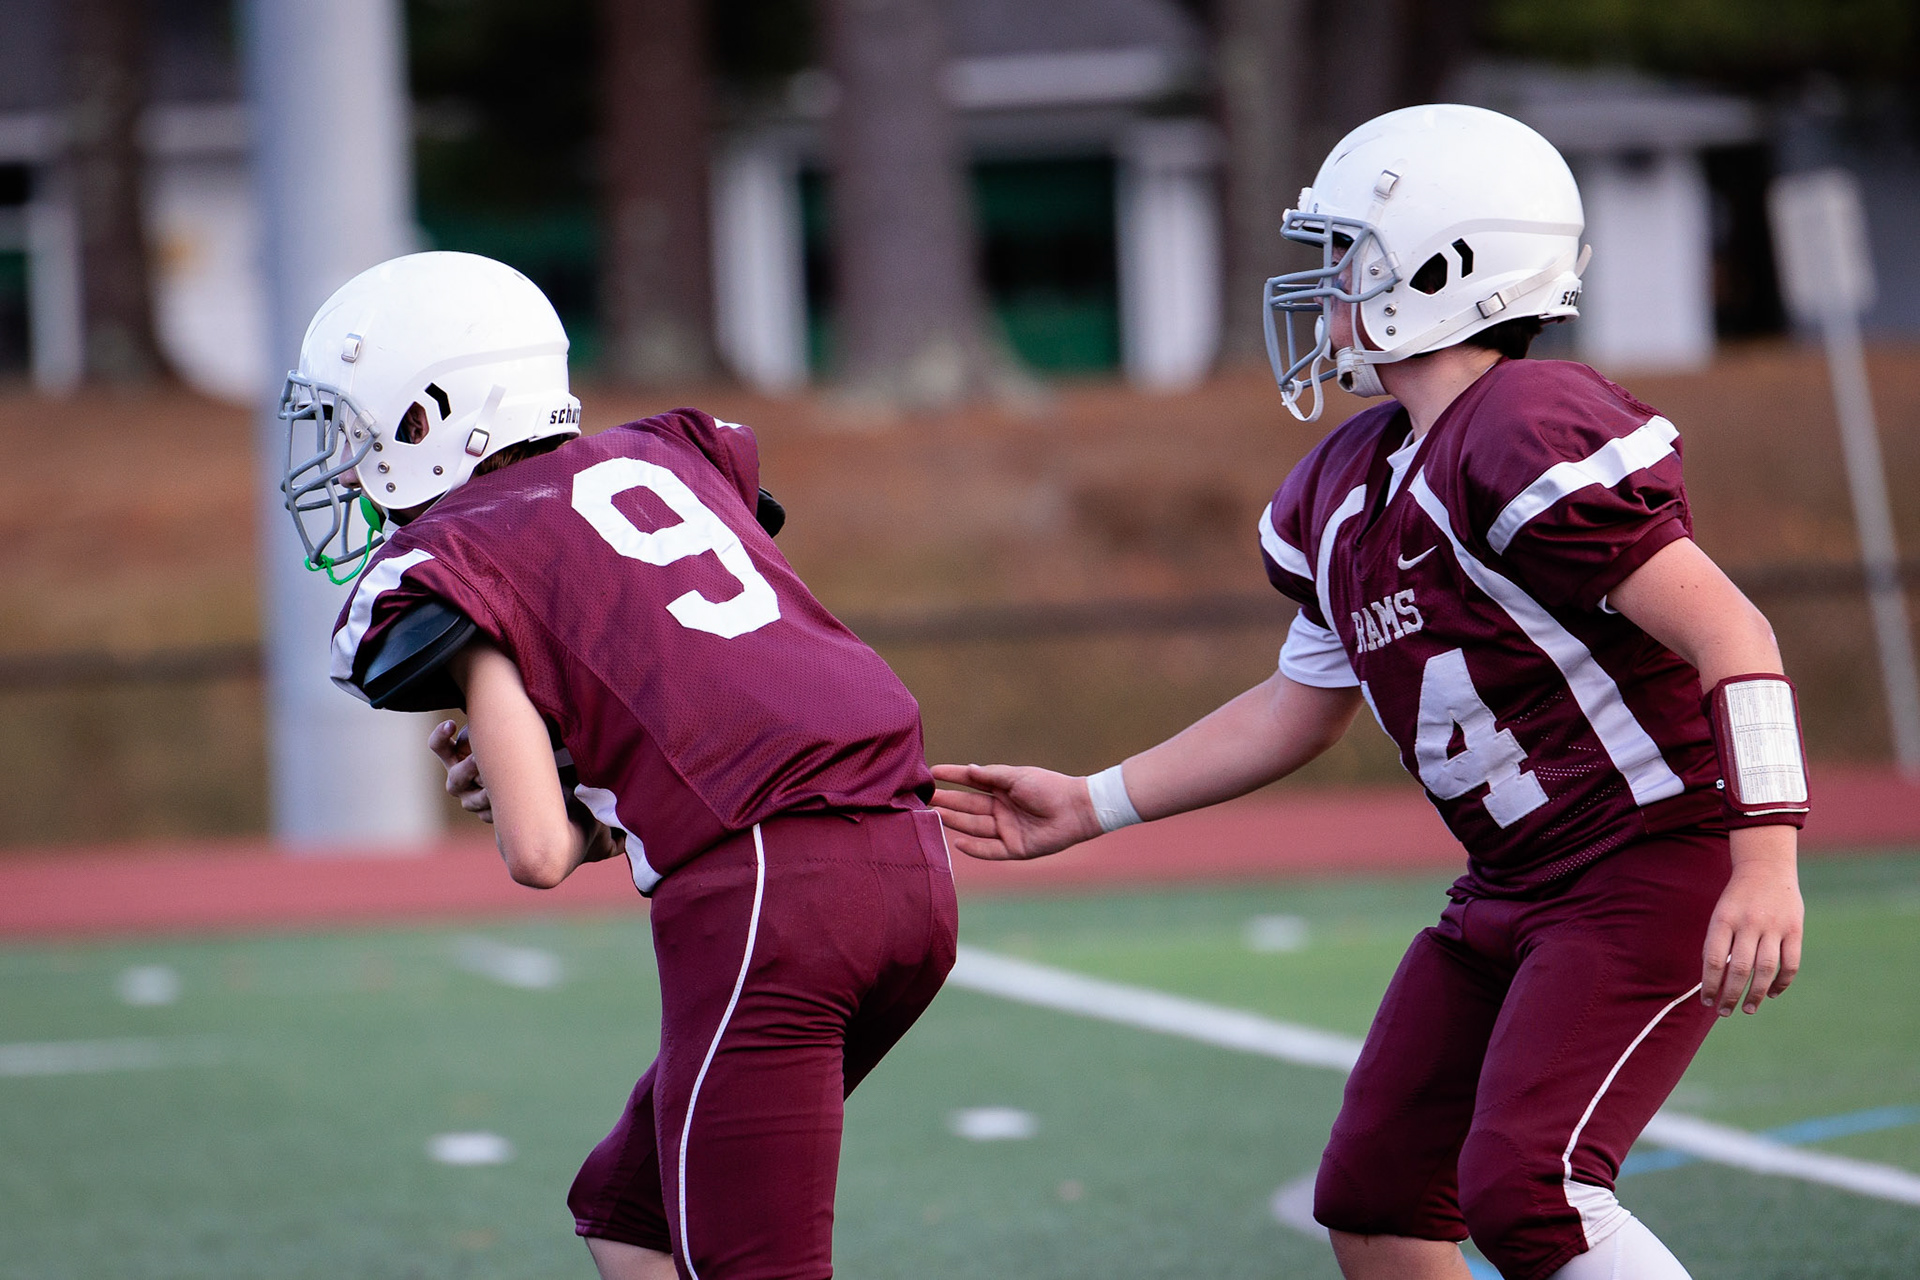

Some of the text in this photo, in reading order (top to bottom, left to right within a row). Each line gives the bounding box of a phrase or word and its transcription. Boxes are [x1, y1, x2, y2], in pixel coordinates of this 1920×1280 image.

[571, 456, 782, 640] 9
[1350, 588, 1424, 654] RAMS
[1414, 647, 1550, 829] 4
